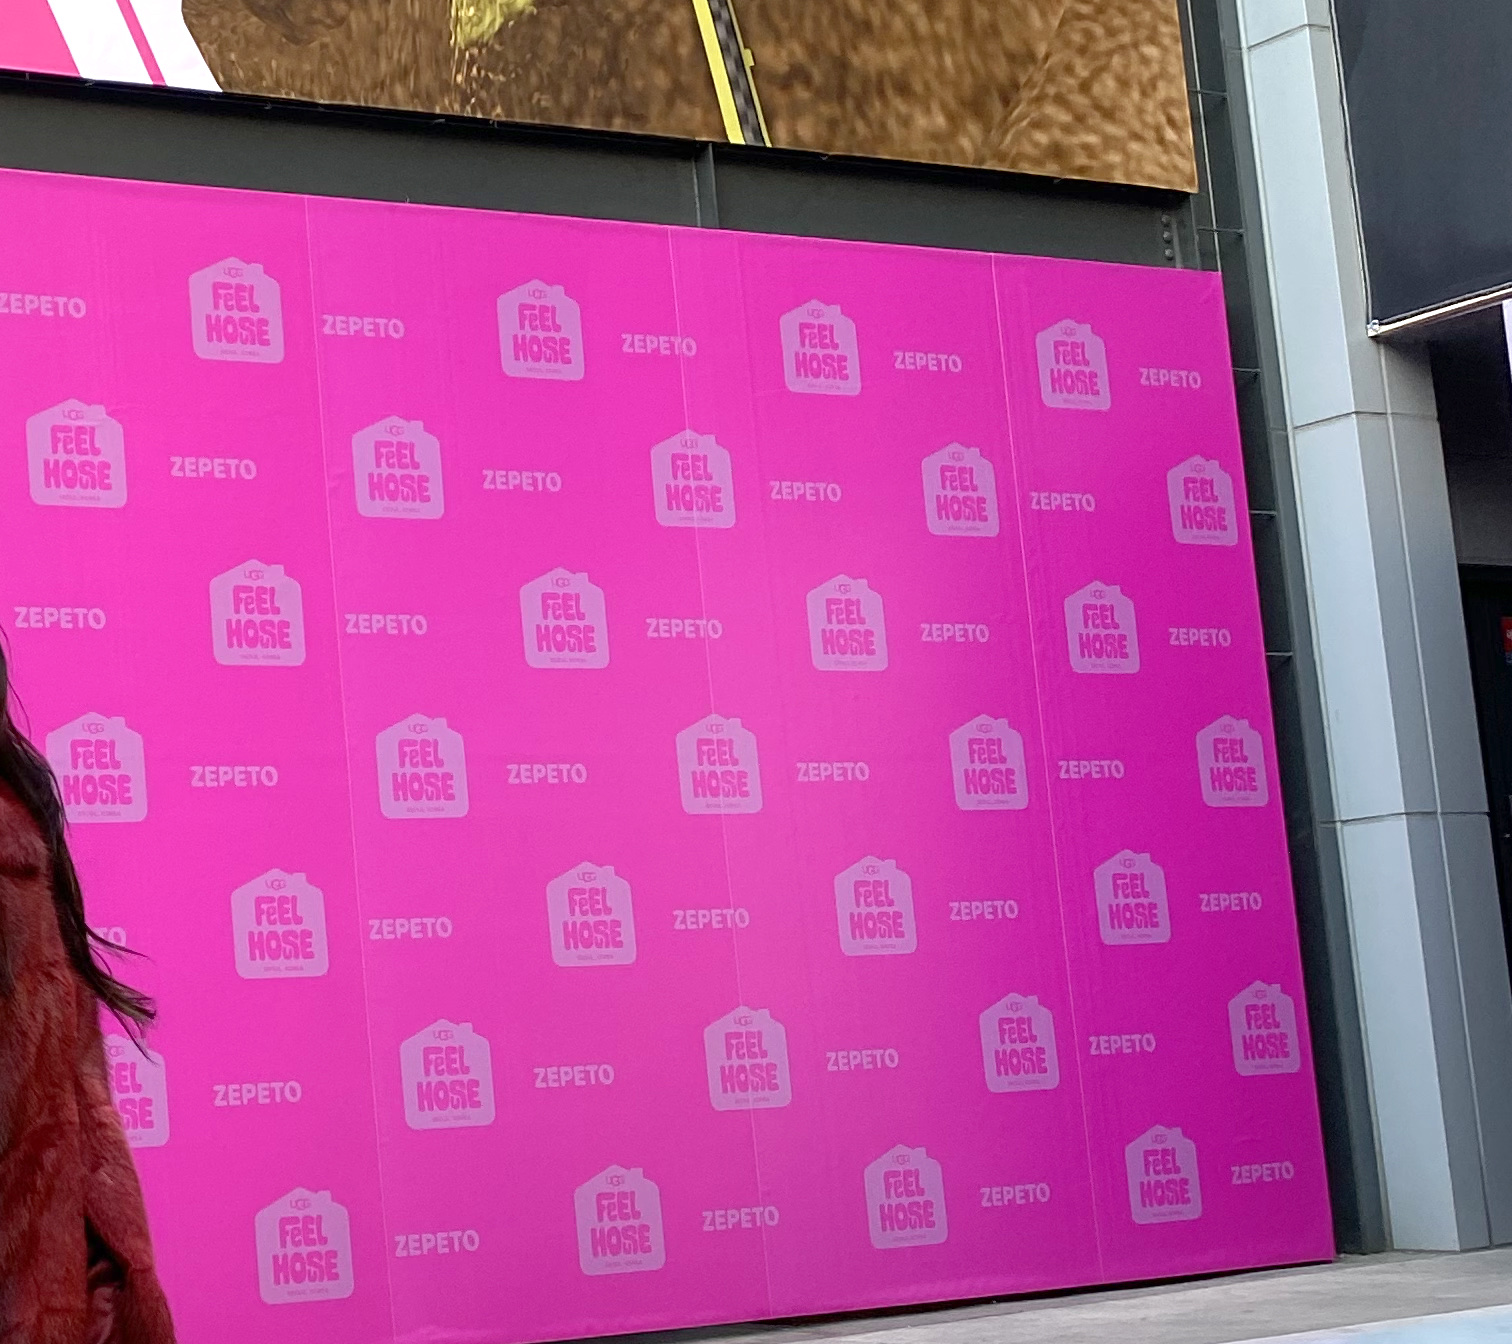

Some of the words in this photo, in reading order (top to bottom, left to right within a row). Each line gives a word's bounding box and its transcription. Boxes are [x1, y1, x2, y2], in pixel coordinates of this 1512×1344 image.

[321, 314, 405, 339] ZEPETO
[621, 333, 697, 357] ZEPETO
[893, 350, 962, 373] ZEPETO
[1138, 367, 1202, 389] ZEPETO
[169, 455, 258, 480] ZEPETO
[482, 469, 562, 492] ZEPETO
[769, 480, 842, 502] ZEPETO
[1029, 491, 1095, 512] ZEPETO
[13, 606, 107, 629] ZEPETO
[344, 613, 428, 635] ZEPETO
[646, 618, 723, 639] ZEPETO
[920, 622, 990, 643] ZEPETO
[1168, 627, 1231, 646] ZEPETO
[189, 765, 279, 787] ZEPETO
[507, 763, 588, 784] ZEPETO
[796, 762, 870, 782] ZEPETO
[1058, 760, 1125, 779] ZEPETO
[949, 899, 1019, 921] ZEPETO
[1198, 891, 1262, 912] ZEPETO
[367, 916, 453, 940] ZEPETO
[673, 907, 750, 930] ZEPETO
[1088, 1033, 1156, 1055] ZEPETO
[825, 1047, 899, 1072] ZEPETO
[533, 1063, 615, 1089] ZEPETO
[213, 1080, 303, 1107] ZEPETO
[1230, 1161, 1295, 1185] ZEPETO
[980, 1182, 1050, 1208] ZEPETO
[702, 1205, 779, 1232] ZEPETO
[394, 1229, 480, 1257] ZEPETO
